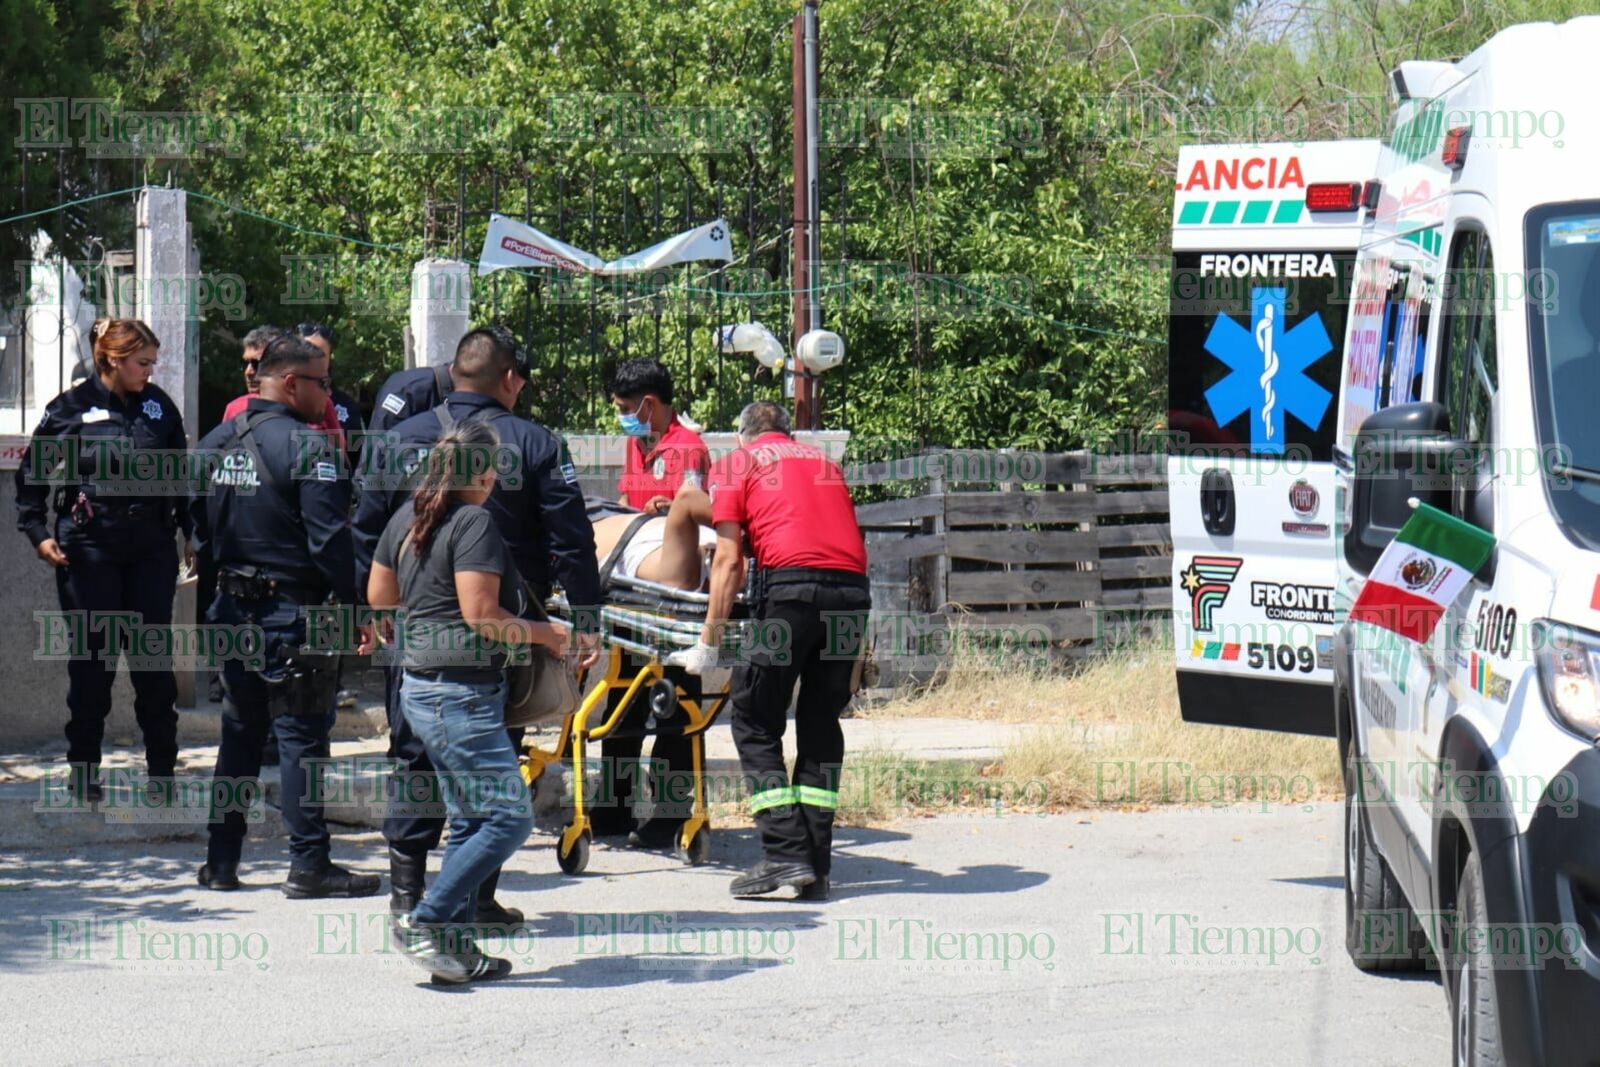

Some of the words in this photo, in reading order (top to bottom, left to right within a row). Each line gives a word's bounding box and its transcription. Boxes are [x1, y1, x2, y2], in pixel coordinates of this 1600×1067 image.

[1200, 254, 1336, 278] FRONTERA
[1295, 490, 1312, 507] FIAT
[1474, 599, 1518, 659] 5109
[1247, 642, 1315, 673] 5109
